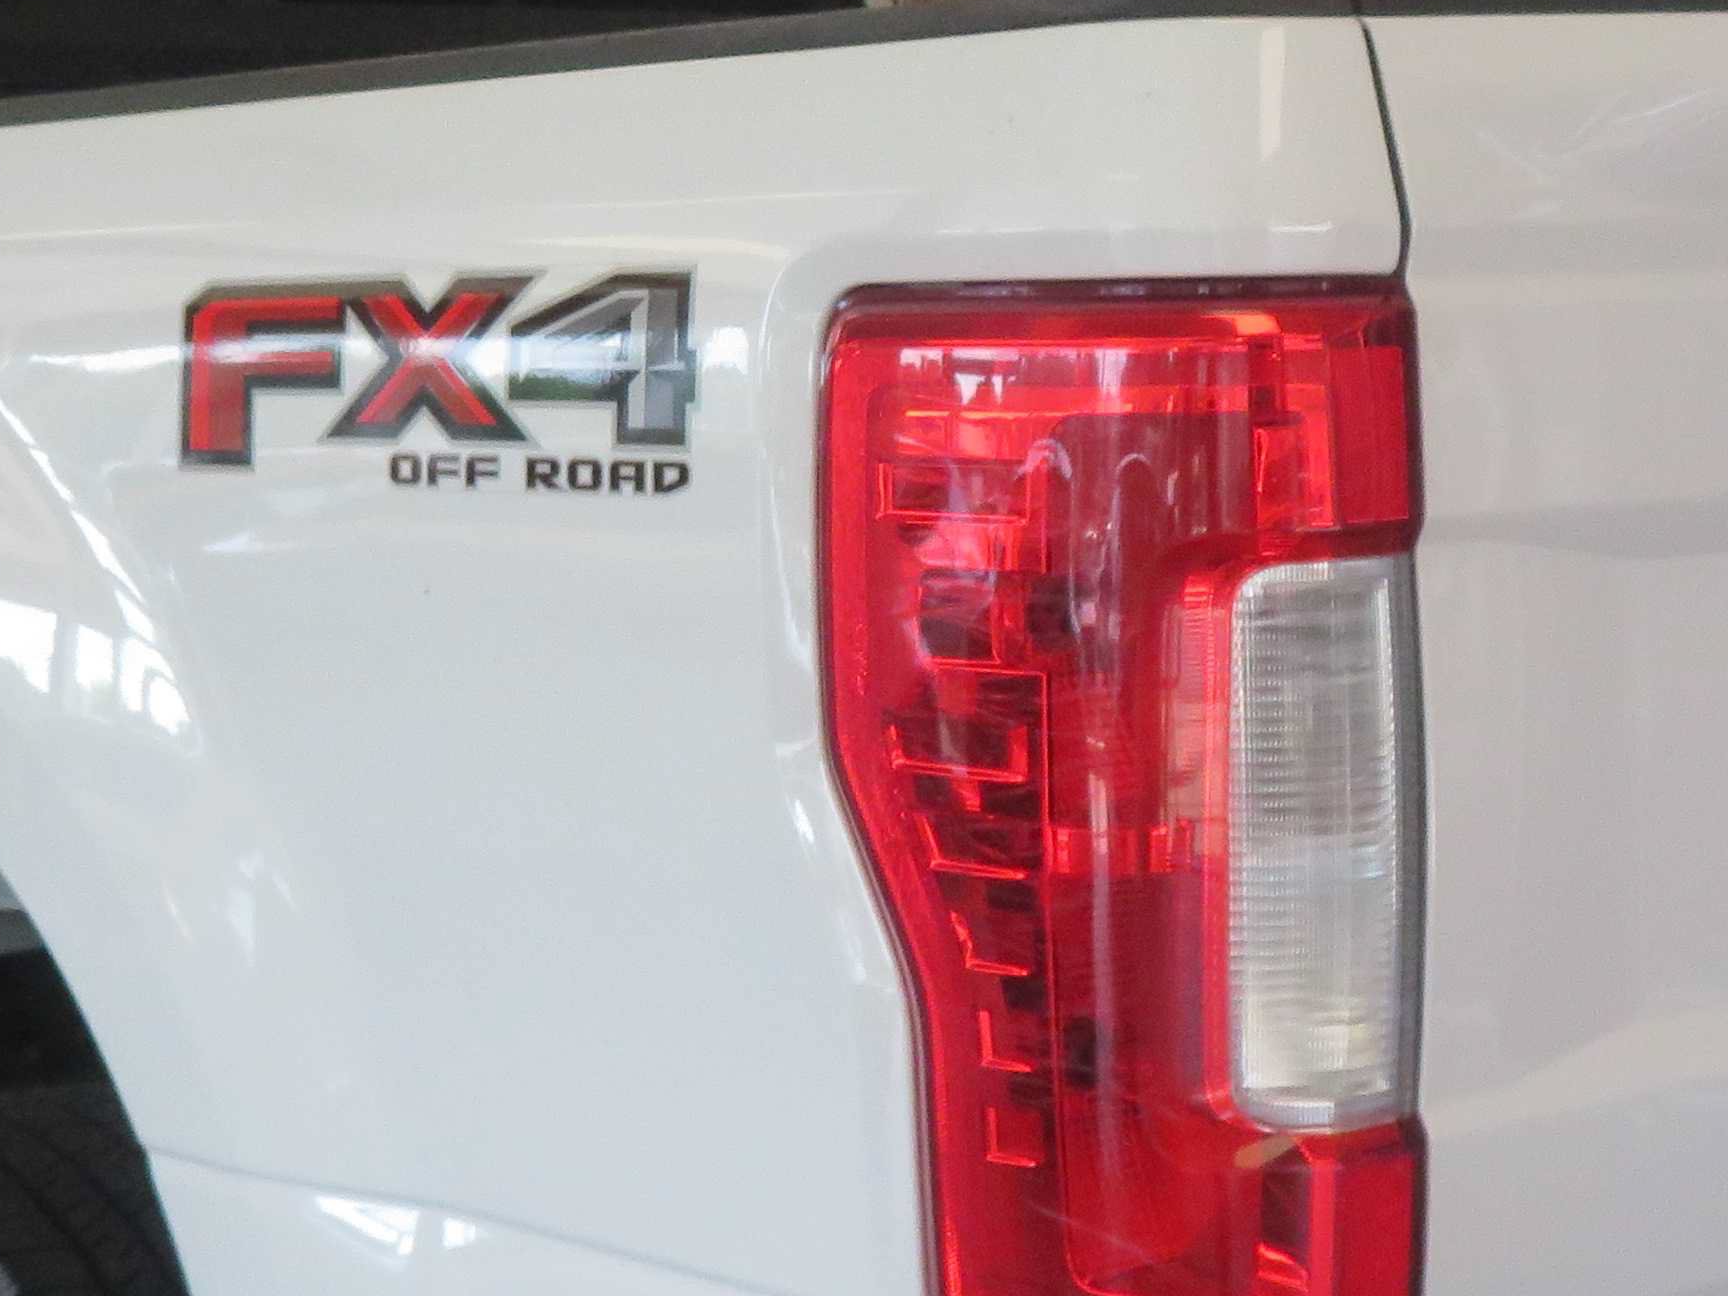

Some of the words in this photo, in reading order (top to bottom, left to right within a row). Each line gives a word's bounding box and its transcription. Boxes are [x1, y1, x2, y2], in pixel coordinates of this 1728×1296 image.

[179, 265, 697, 470] FX4
[388, 453, 500, 487] OFF
[525, 456, 691, 494] ROAD
